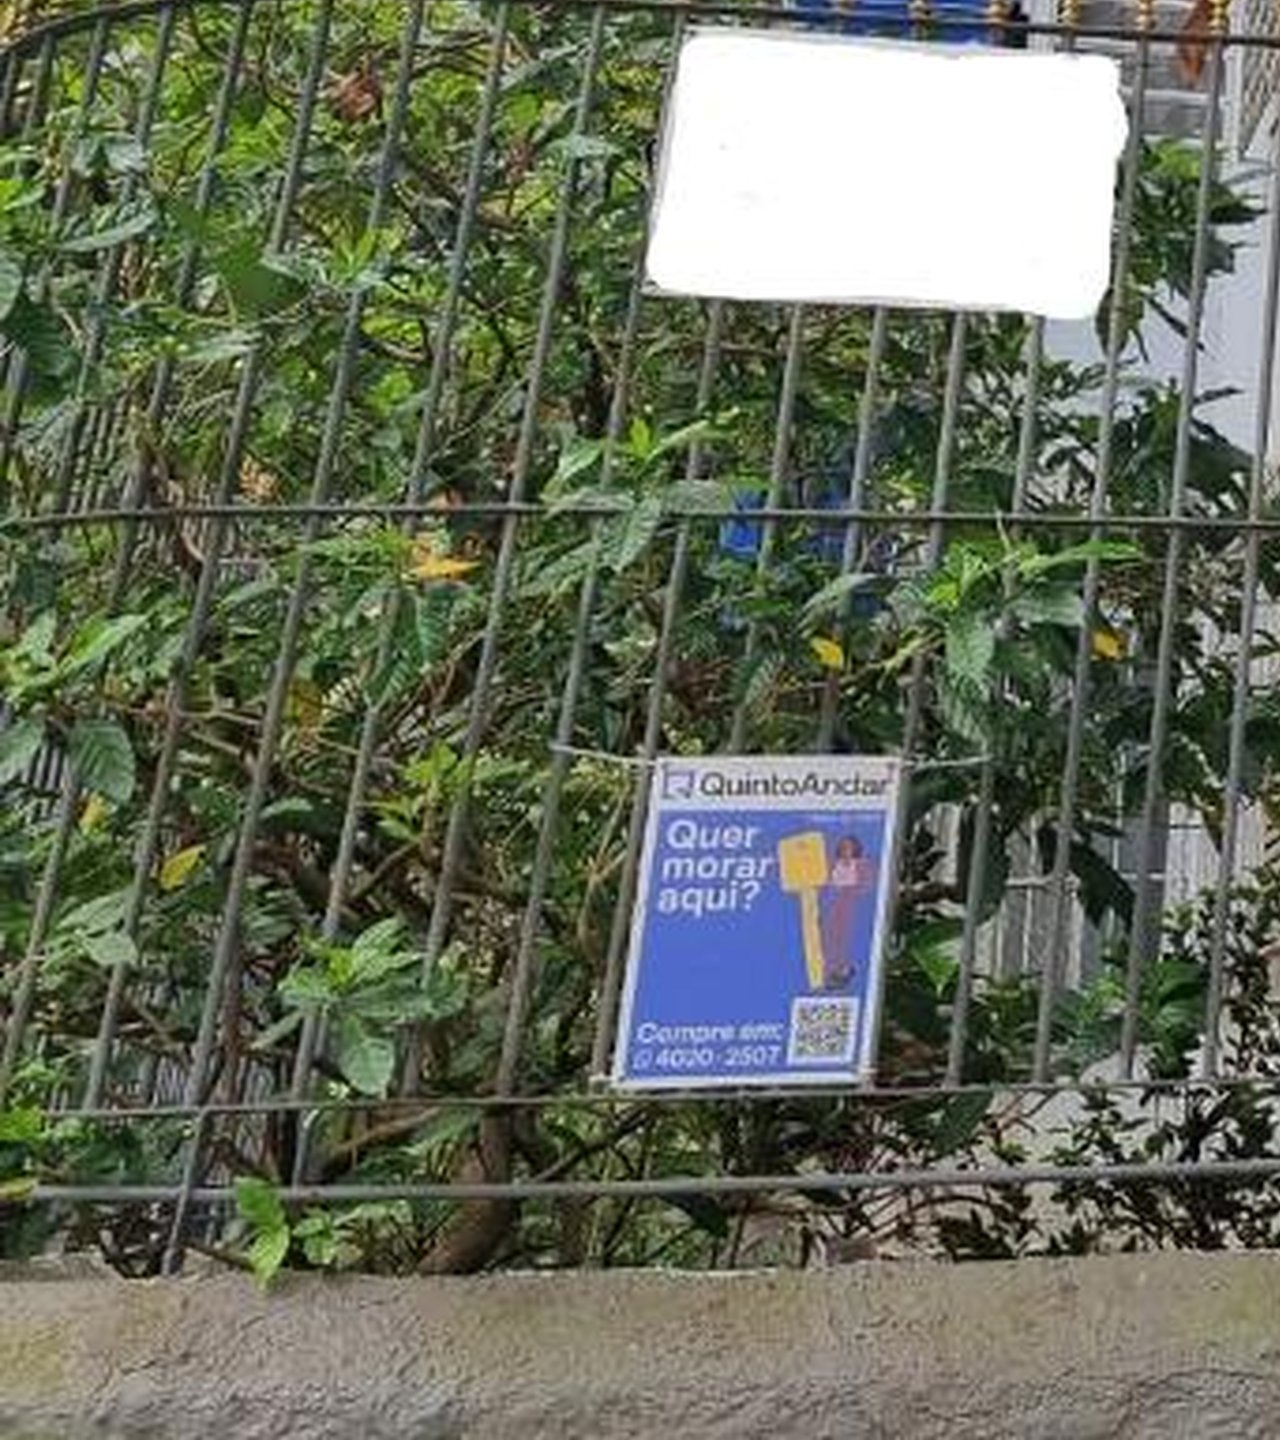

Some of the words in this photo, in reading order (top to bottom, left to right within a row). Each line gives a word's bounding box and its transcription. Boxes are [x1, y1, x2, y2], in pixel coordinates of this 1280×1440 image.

[700, 771, 890, 797] QuintoAndar
[666, 819, 761, 850] Quer
[661, 857, 776, 880] morar
[658, 880, 762, 918] aqui?
